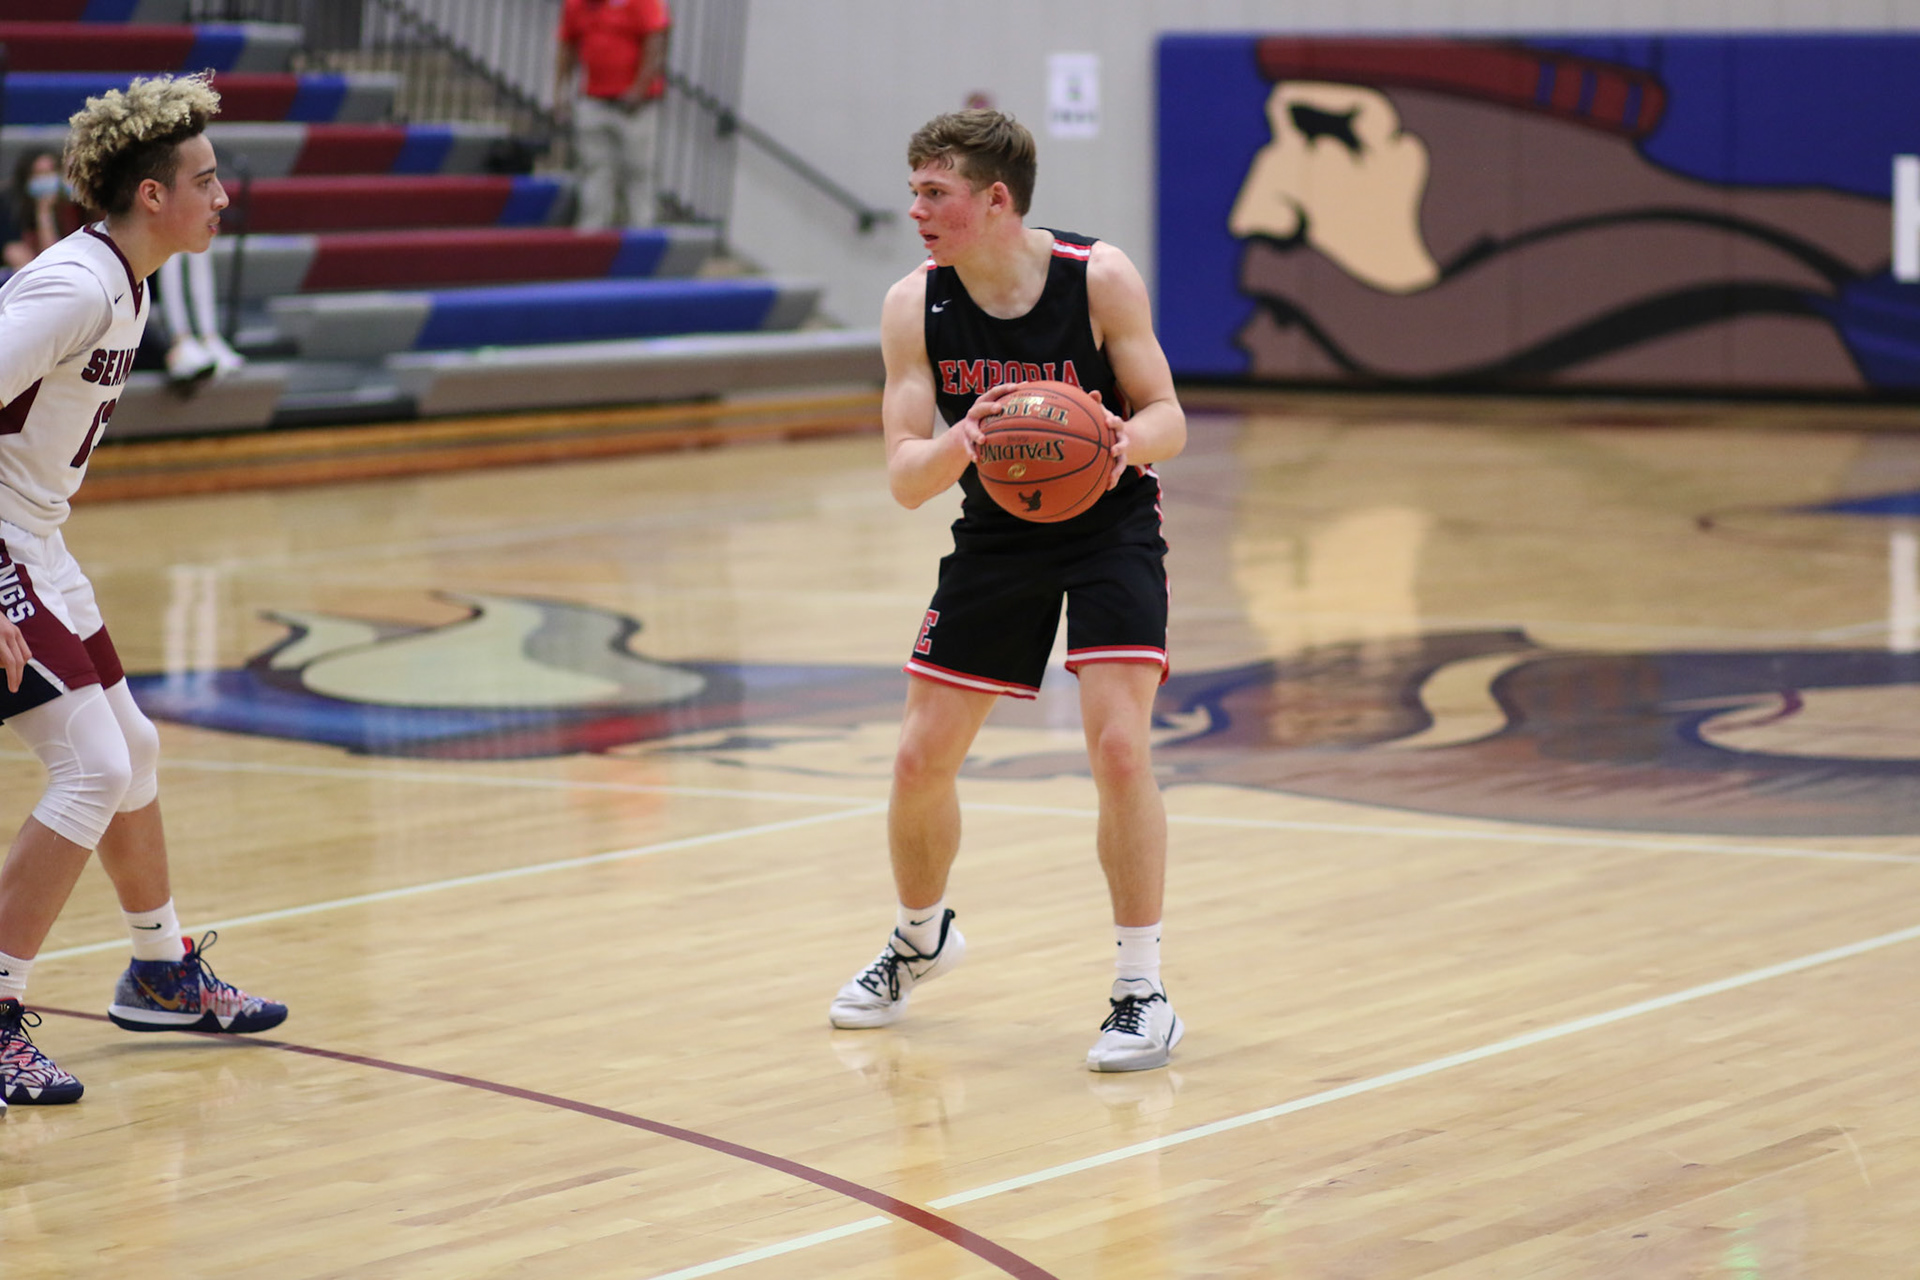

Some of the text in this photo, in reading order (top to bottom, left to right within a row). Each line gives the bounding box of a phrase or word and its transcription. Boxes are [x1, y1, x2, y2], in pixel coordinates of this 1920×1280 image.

[938, 358, 1083, 395] EMPORIA
[980, 439, 1065, 465] SPALDING
[0, 555, 36, 624] NGS
[915, 608, 941, 656] E
